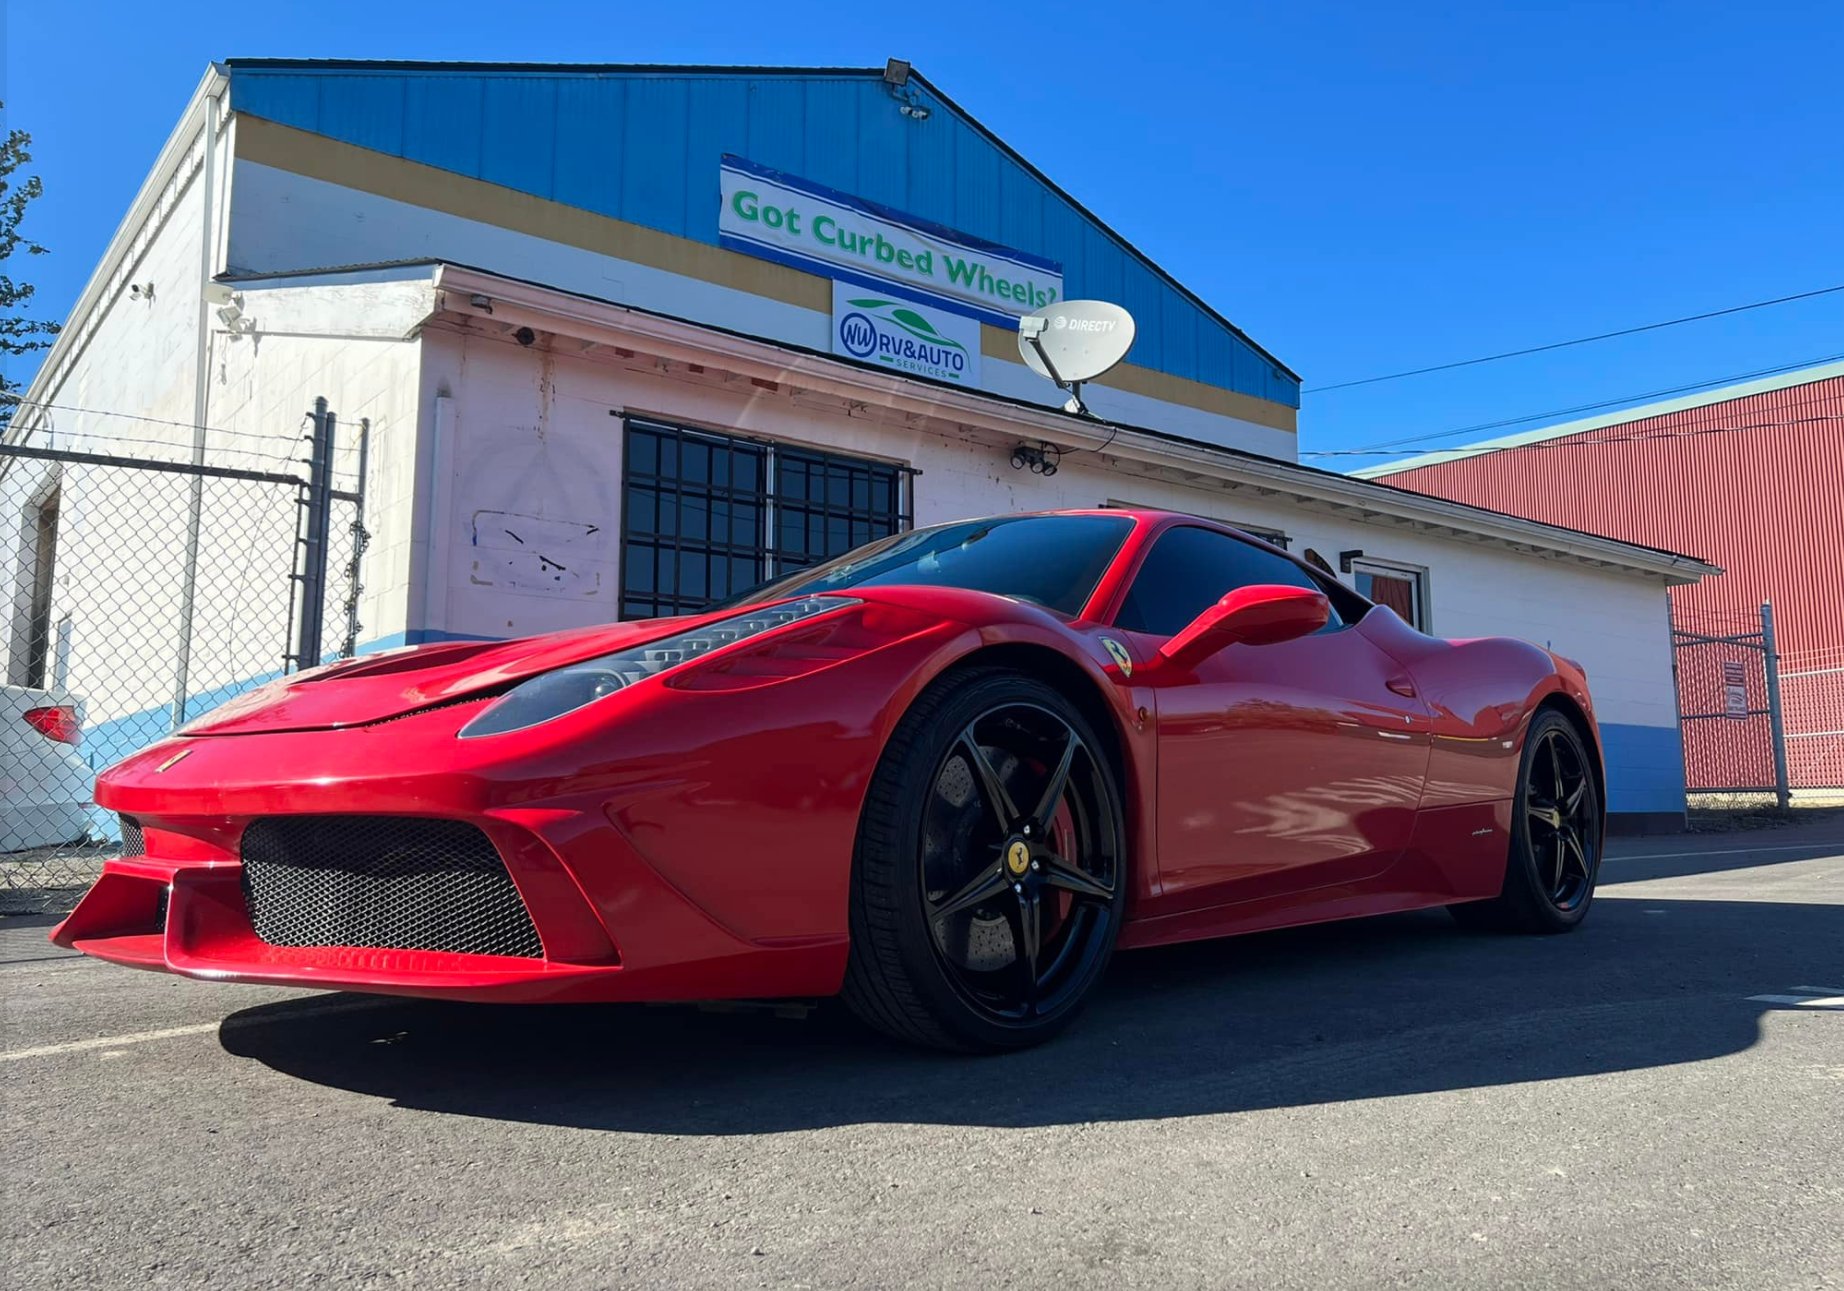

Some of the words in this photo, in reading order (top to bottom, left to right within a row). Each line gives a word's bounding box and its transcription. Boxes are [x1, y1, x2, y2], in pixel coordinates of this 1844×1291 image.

[731, 190, 802, 236] Got
[811, 214, 934, 276] Curbed
[943, 254, 1057, 309] Wheels?
[845, 322, 873, 348] NW
[879, 333, 964, 371] RV&AUTO
[896, 358, 948, 378] SERVICES
